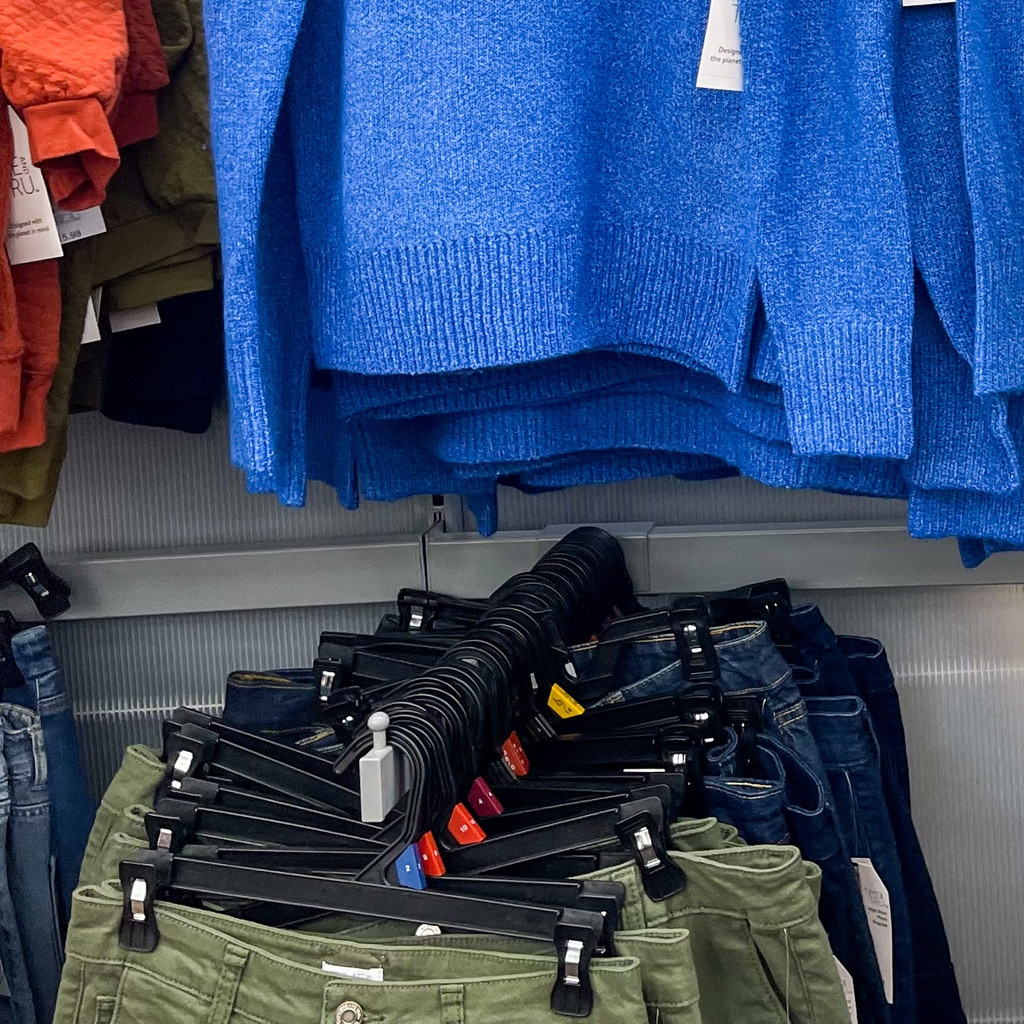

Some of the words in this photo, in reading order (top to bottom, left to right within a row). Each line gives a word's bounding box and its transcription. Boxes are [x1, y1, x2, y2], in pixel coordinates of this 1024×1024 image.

[11, 175, 35, 198] RU
[61, 229, 82, 242] 5.98
[459, 824, 469, 833] 10
[404, 864, 411, 873] 2
